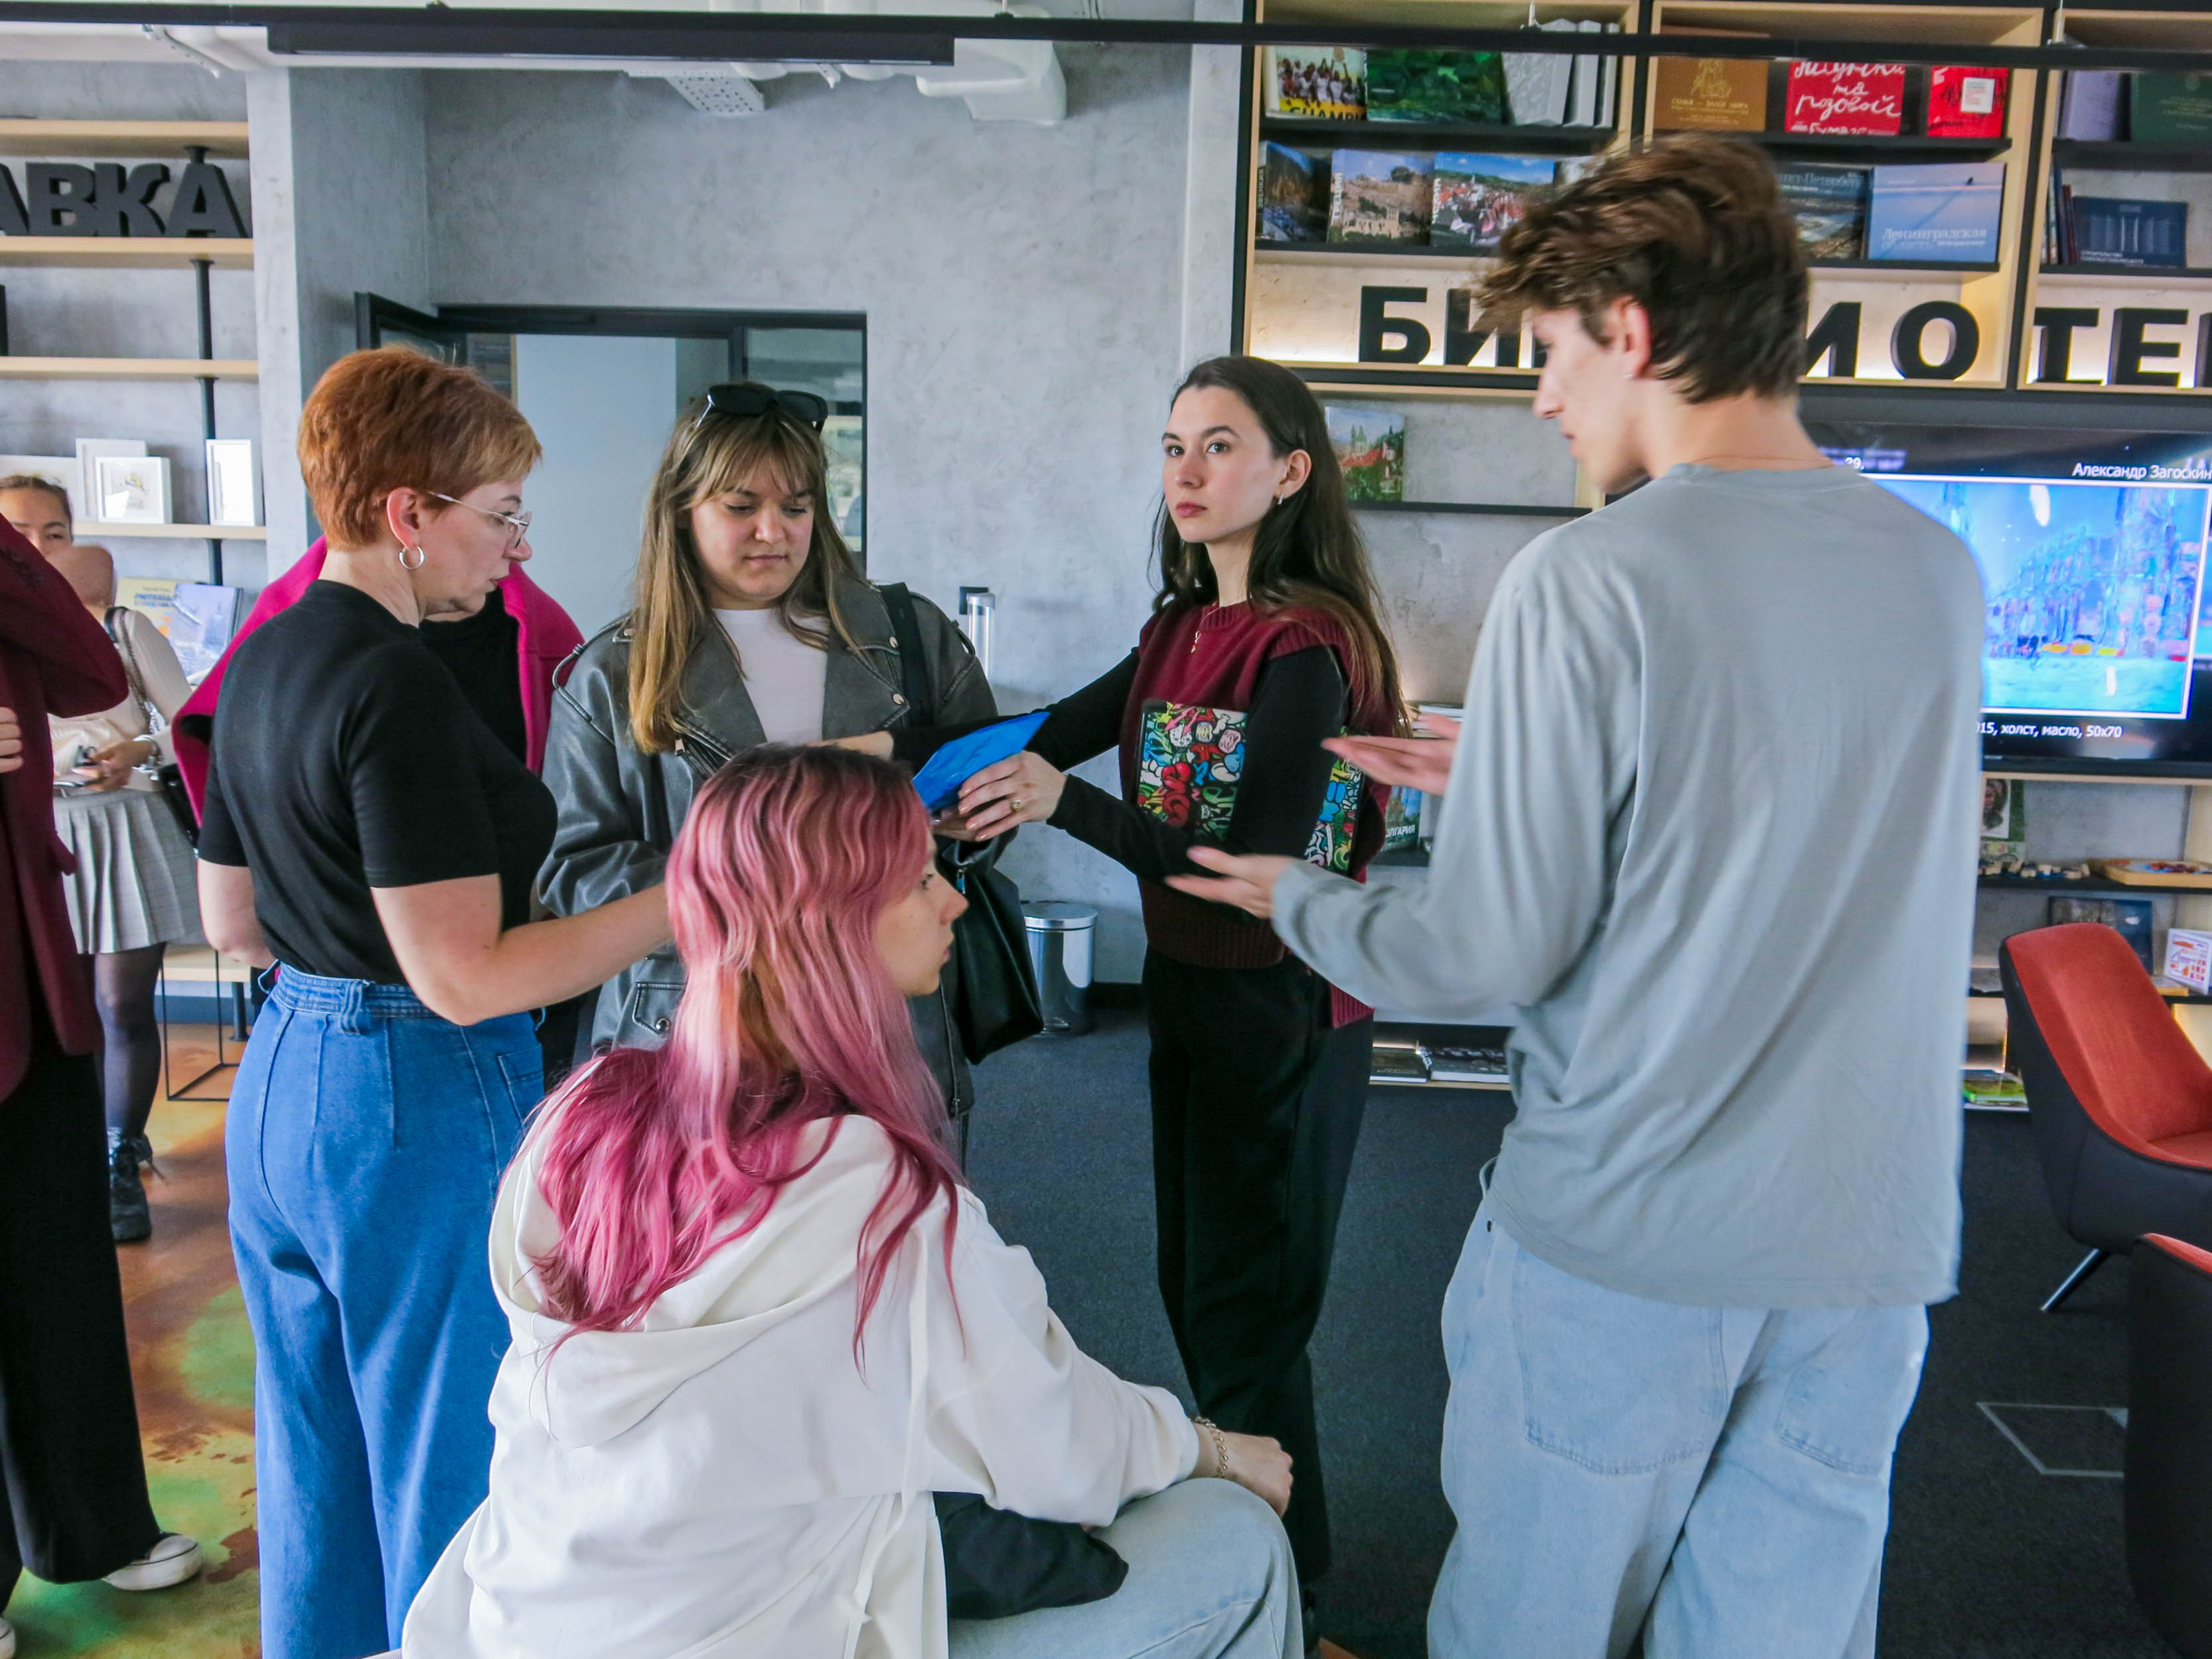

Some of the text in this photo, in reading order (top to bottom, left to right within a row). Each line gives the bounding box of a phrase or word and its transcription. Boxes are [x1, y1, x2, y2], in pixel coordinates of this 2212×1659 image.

[1795, 95, 1902, 121] розовой
[2071, 462, 2212, 480] Александр Загоскин
[1977, 721, 1998, 736] 15,
[2000, 725, 2039, 737] холст,
[2041, 727, 2083, 739] масло,
